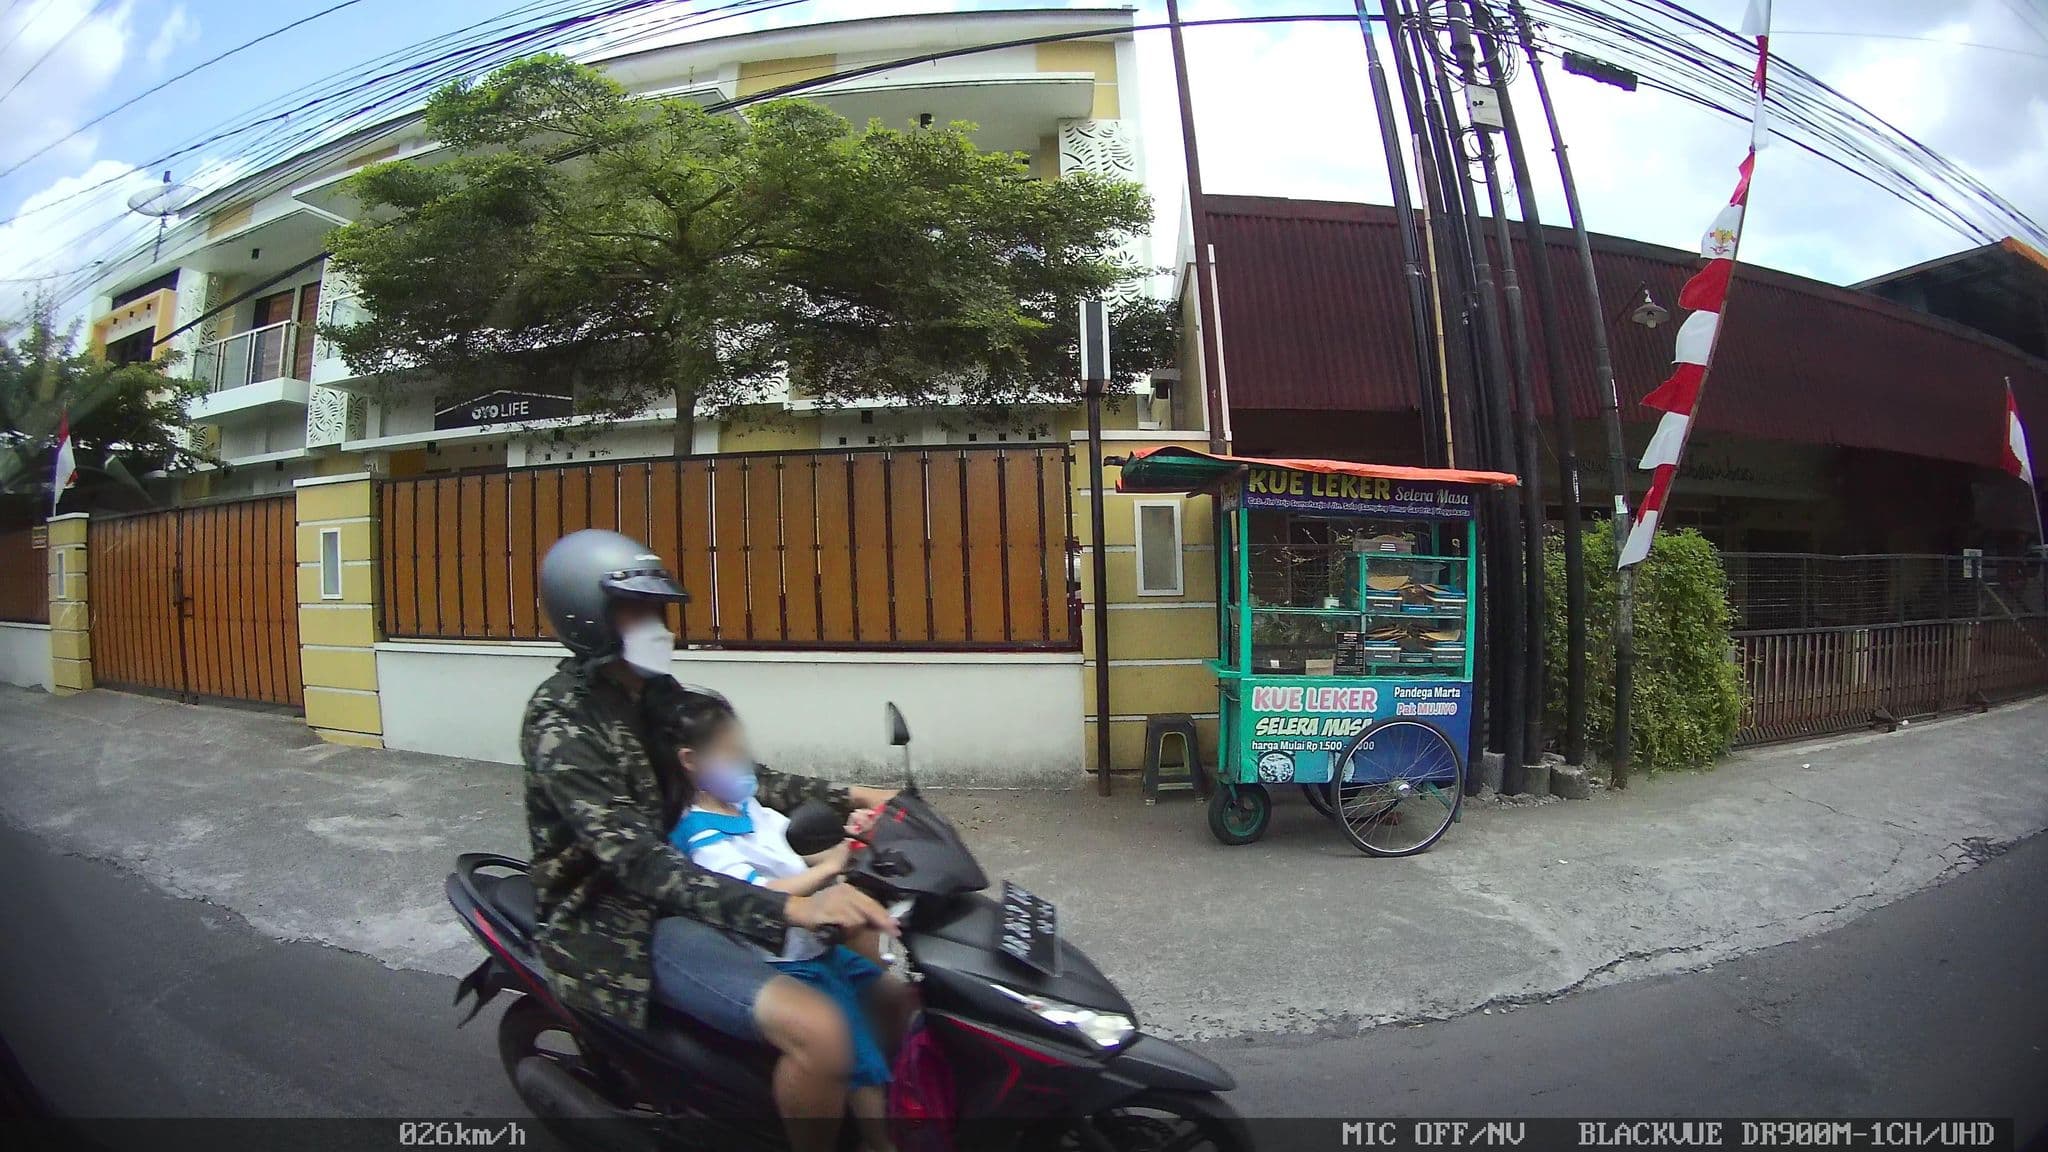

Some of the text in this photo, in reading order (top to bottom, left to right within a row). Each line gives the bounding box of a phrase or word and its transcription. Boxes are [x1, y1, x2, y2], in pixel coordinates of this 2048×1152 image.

[471, 401, 529, 420] OYO LIFE
[1249, 469, 1390, 500] KUE LEKER
[1395, 487, 1468, 504] Selera Masa
[1252, 686, 1378, 712] KUE LEKER
[1394, 687, 1461, 700] Pandega Marta
[1396, 702, 1417, 716] Pak
[1255, 717, 1320, 736] SELERA
[1252, 741, 1279, 752] harga
[1280, 740, 1305, 750] Mulai
[1306, 741, 1318, 752] Rp
